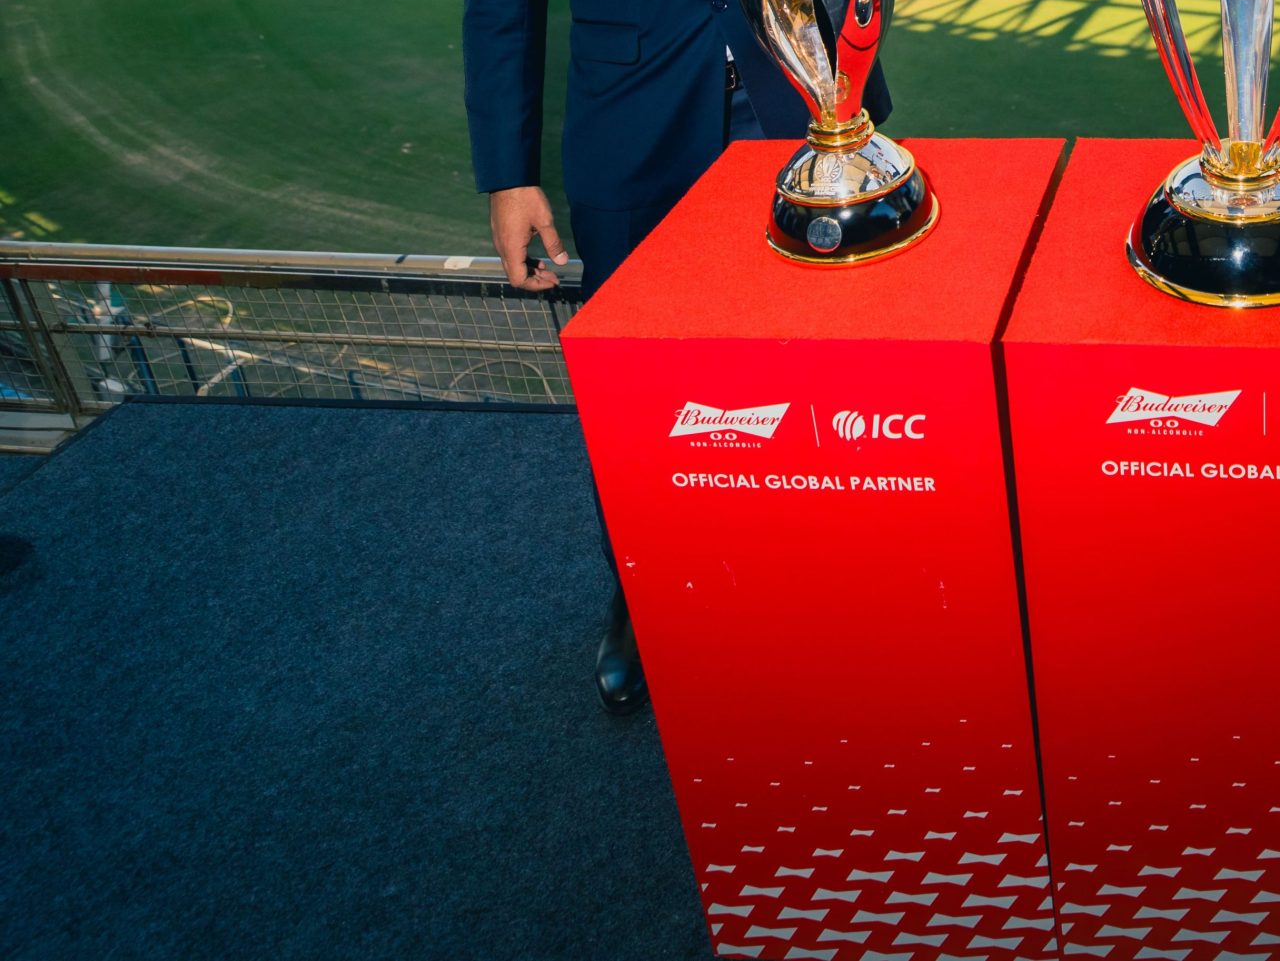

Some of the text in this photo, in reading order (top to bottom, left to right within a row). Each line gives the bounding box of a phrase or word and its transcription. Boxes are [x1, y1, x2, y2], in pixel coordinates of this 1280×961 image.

[1115, 394, 1230, 414] Budweiser
[673, 409, 781, 427] Budweiser
[871, 414, 926, 439] ICC
[1150, 420, 1179, 429] 0.0
[710, 432, 737, 441] 0.0
[1127, 428, 1204, 436] NON-ALCOHOLIC
[1101, 460, 1194, 478] OFFICIAL
[671, 472, 936, 492] OFFICIAL GLOBAL PARTNER
